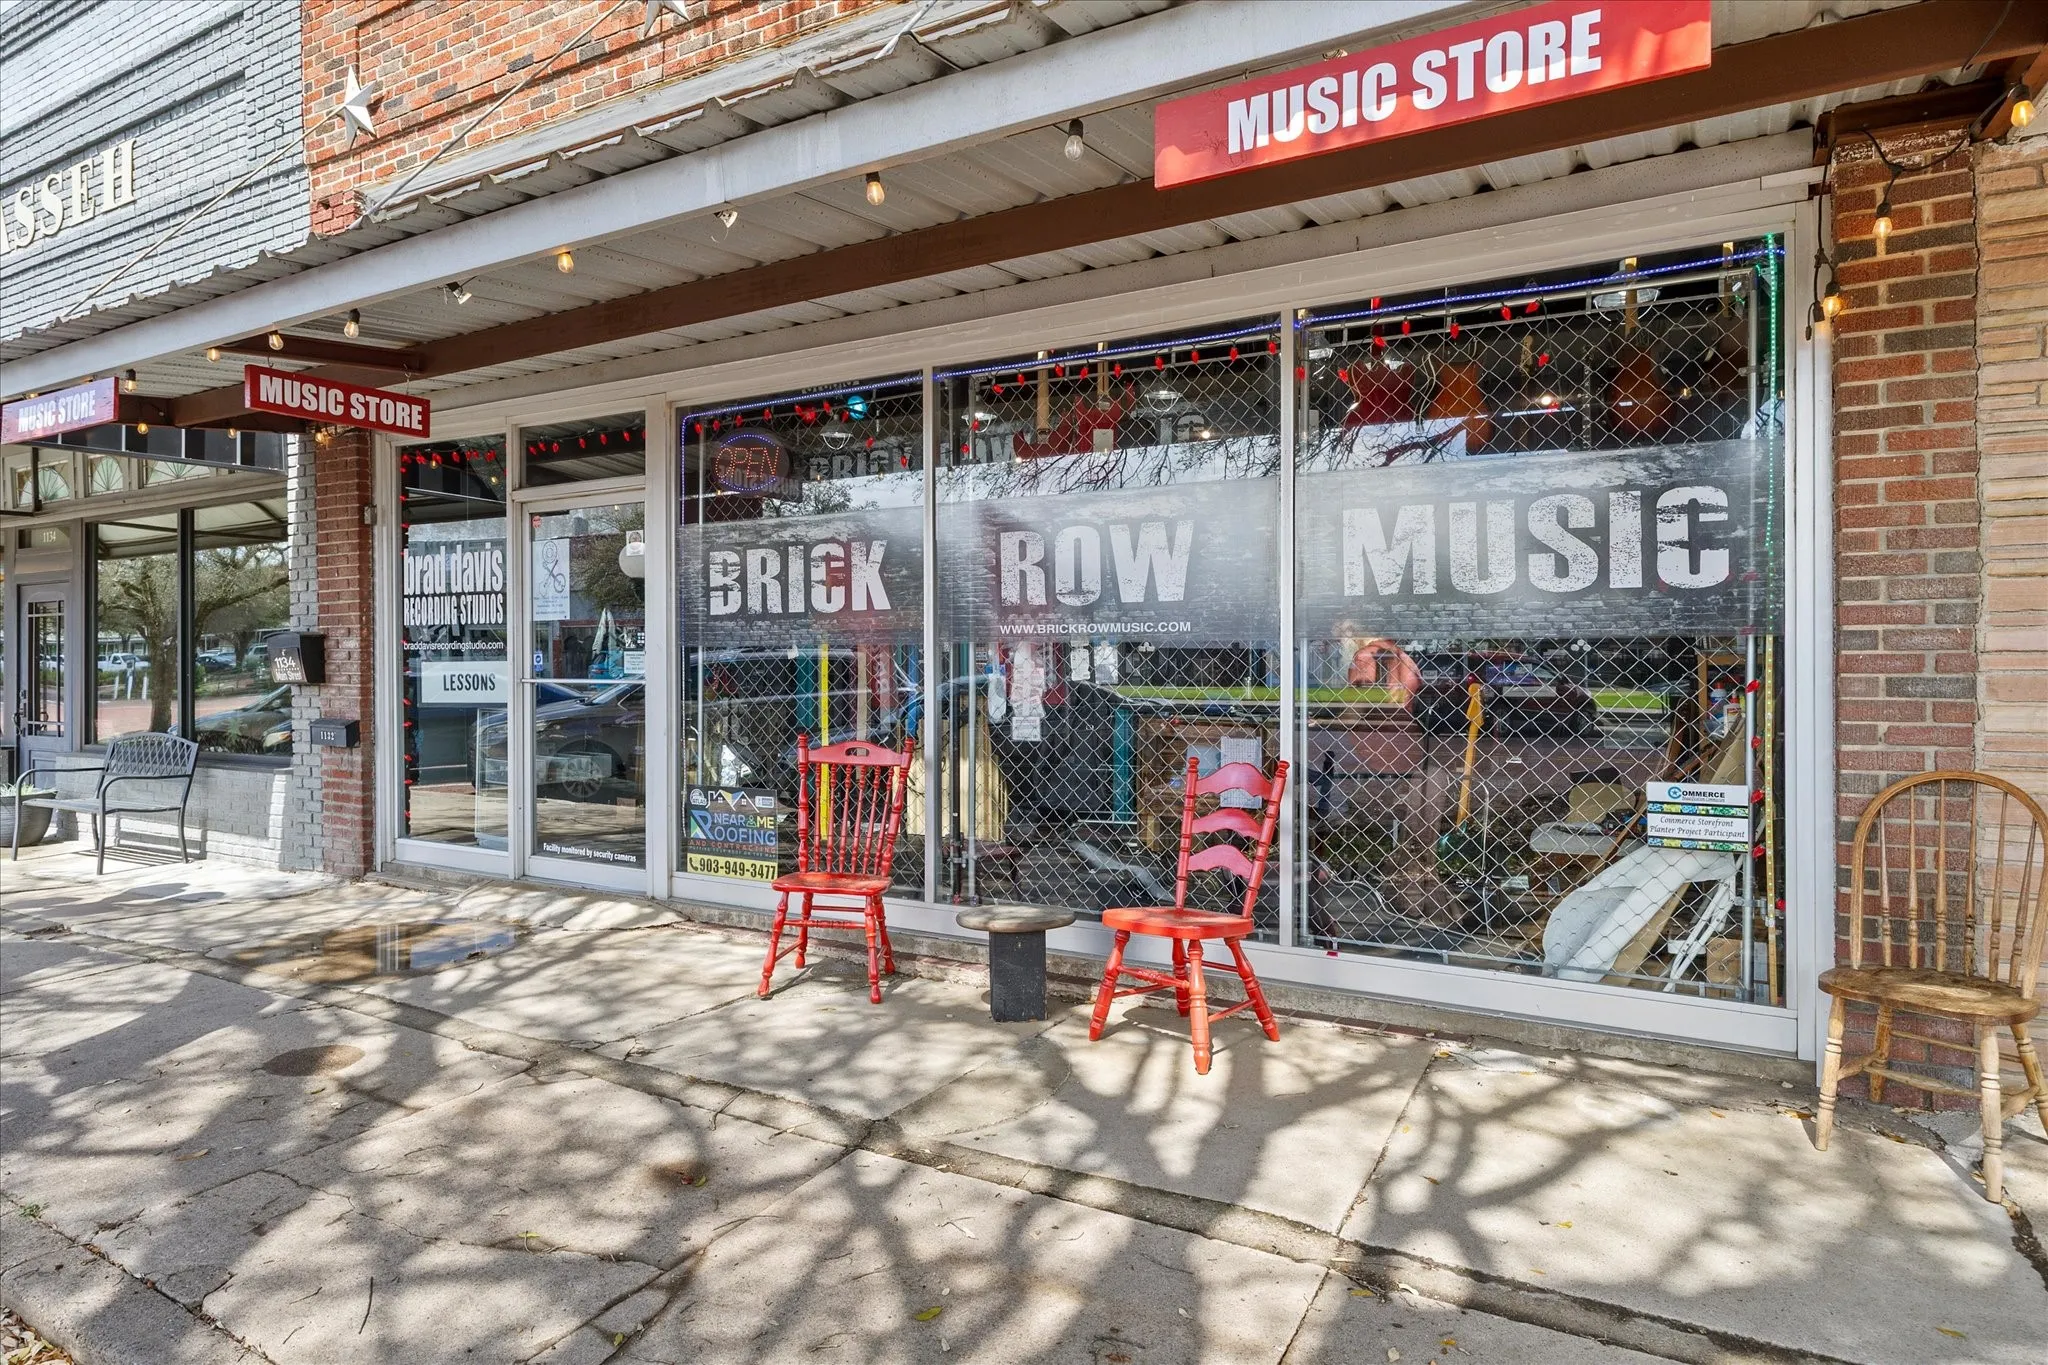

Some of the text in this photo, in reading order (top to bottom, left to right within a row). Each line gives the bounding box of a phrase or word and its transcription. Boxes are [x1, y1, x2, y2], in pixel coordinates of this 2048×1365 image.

[1227, 9, 1601, 155] MUSIC STORE
[17, 389, 96, 433] MUSIC STORE
[259, 373, 423, 431] MUSIC STORE
[715, 446, 780, 479] OPEN
[1342, 485, 1730, 597] MUSIC
[403, 542, 503, 595] brad davis
[1000, 520, 1195, 607] ROW
[709, 539, 891, 616] BRICK
[403, 595, 458, 626] RECORDING
[460, 593, 503, 626] STUDIOS
[1000, 621, 1191, 635] WWW.BRICKROWMUSIC.COM
[403, 640, 504, 652] braddavisrecordingstudio.com
[274, 656, 296, 668] 1134
[443, 673, 496, 692] LESSONS
[320, 731, 335, 740] 1132
[1667, 786, 1725, 799] COMMERCE
[690, 809, 776, 846] ROOFING
[714, 812, 775, 829] NEAR ME
[1660, 815, 1734, 828] Commerce Storefront
[1649, 825, 1745, 838] Planter Project Participant
[543, 842, 636, 863] Facility monitored by security cameras
[711, 841, 777, 853] CONTRACTING
[699, 857, 776, 879] 903-949-3477
